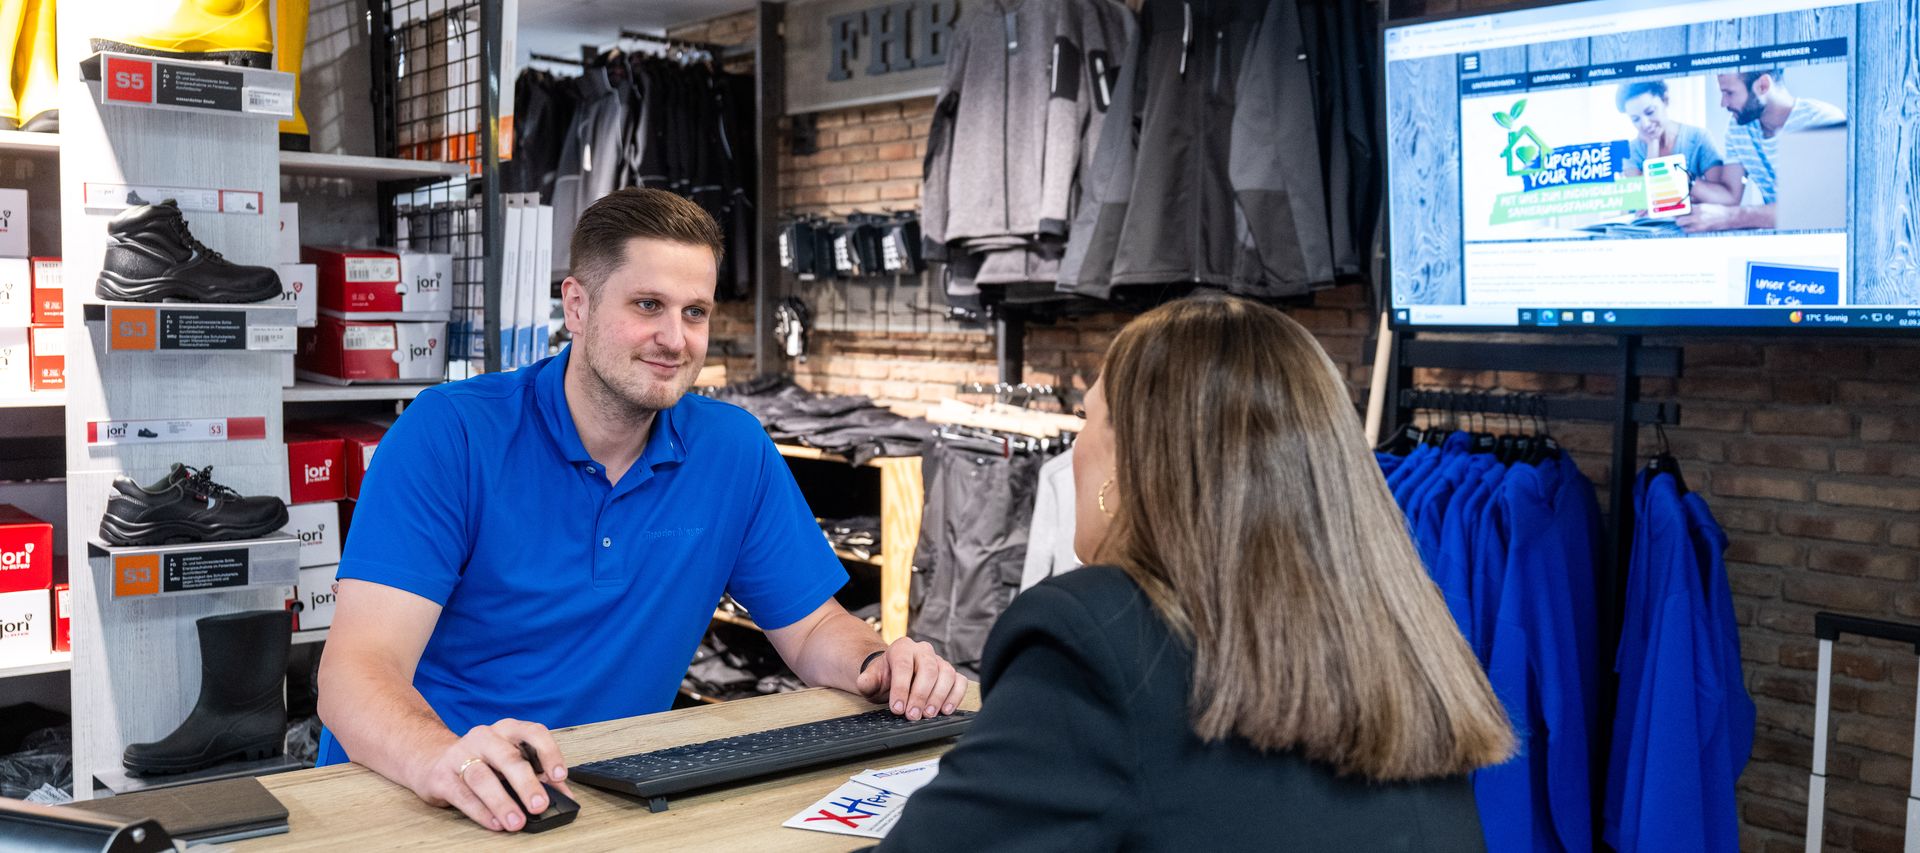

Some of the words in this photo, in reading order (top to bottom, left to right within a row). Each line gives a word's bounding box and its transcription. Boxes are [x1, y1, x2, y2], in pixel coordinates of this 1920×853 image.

[827, 0, 961, 82] FHB
[1471, 78, 1516, 90] UNTERNEHMEN
[1532, 72, 1571, 83] LEISTUNGEN
[1588, 68, 1616, 78] AKTUELL
[1635, 62, 1671, 72] PRODUKTE
[1690, 54, 1740, 66] HANDWERKER
[1761, 47, 1810, 58] HEIMWERKER
[115, 71, 145, 90] S5
[1544, 146, 1612, 170] UPGRADE
[1529, 168, 1568, 187] YOUR
[1570, 162, 1612, 181] HOME
[417, 272, 442, 293] jori
[1756, 278, 1785, 290] Unser
[1788, 280, 1825, 294] Service
[120, 322, 147, 337] S3
[1824, 314, 1848, 323] Sonnig
[410, 338, 436, 361] jori
[107, 423, 128, 439] jori
[211, 426, 221, 434] S3
[305, 459, 332, 484] jori
[297, 524, 324, 547] jori
[0, 543, 34, 570] ori
[123, 568, 151, 584] S3
[312, 584, 338, 610] jori
[0, 613, 33, 640] jori
